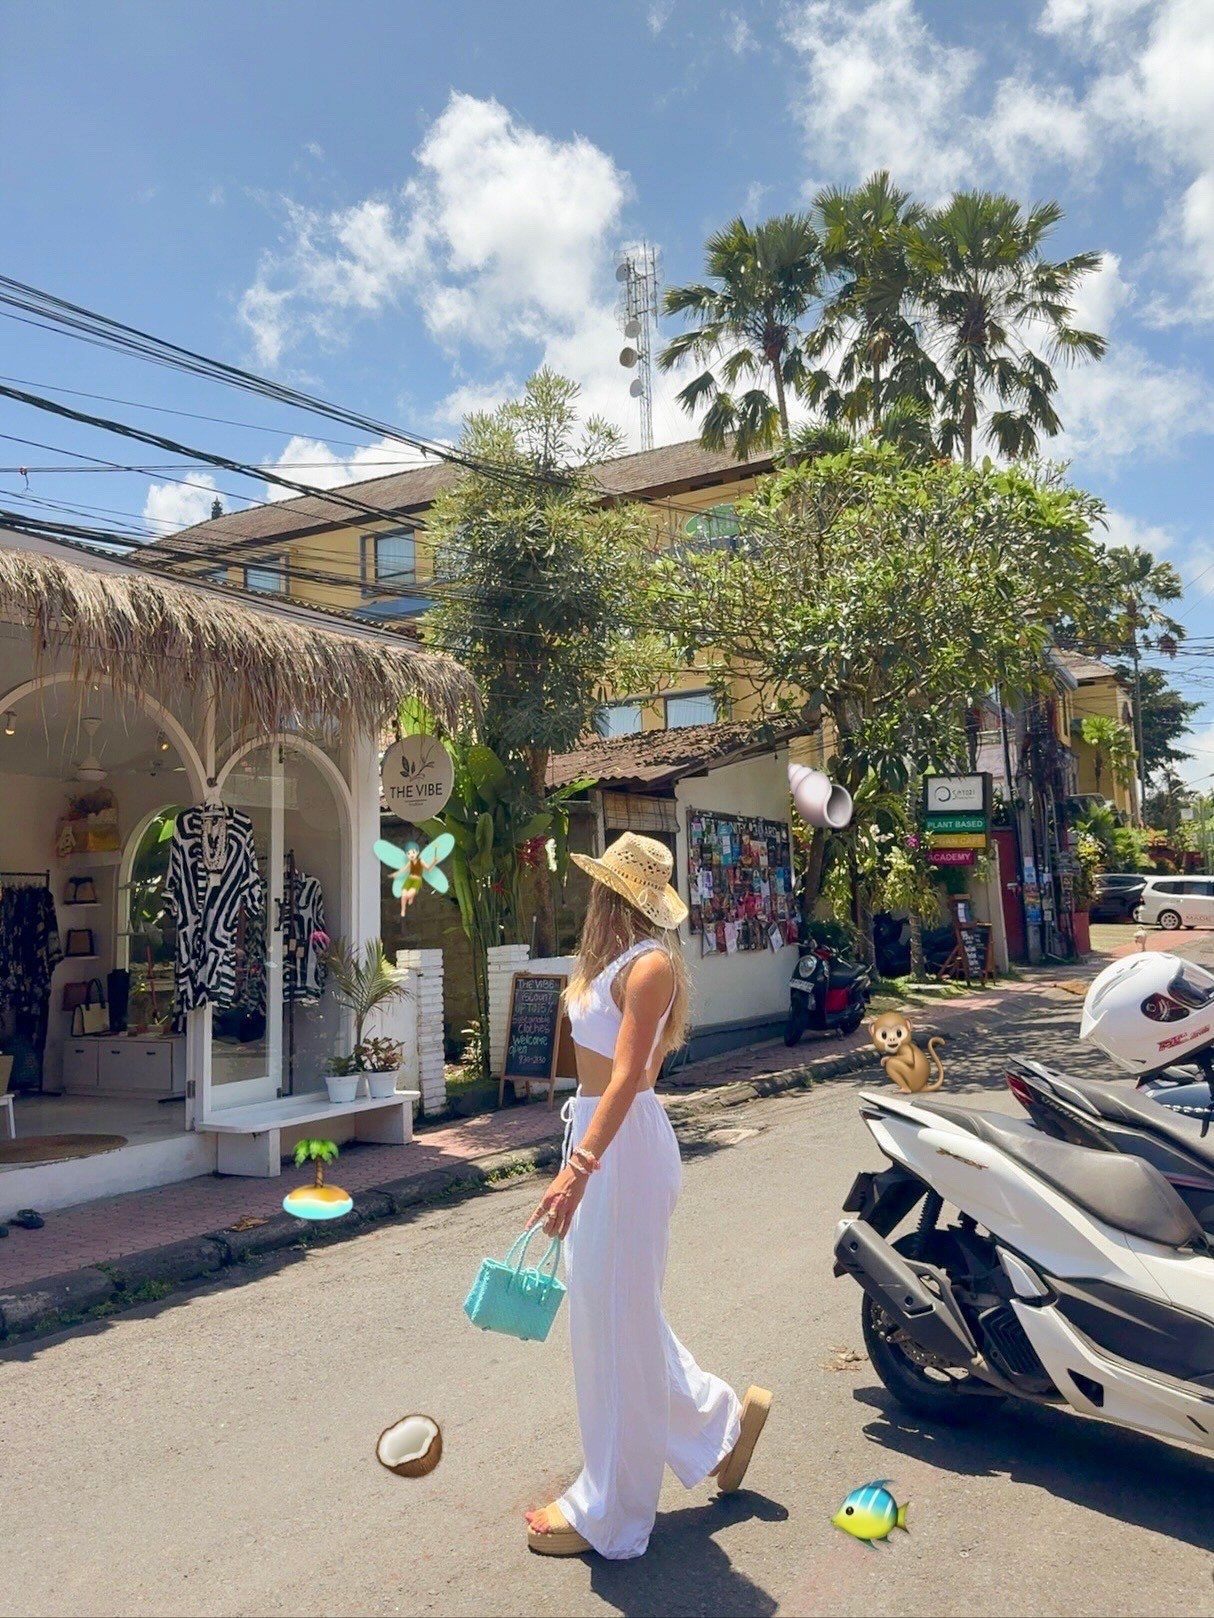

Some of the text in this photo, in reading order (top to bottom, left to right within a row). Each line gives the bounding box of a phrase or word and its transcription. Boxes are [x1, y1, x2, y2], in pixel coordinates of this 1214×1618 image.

[390, 783, 443, 799] THE VIBE
[927, 820, 983, 829] PLANT BASED
[928, 852, 971, 862] ACADEMY
